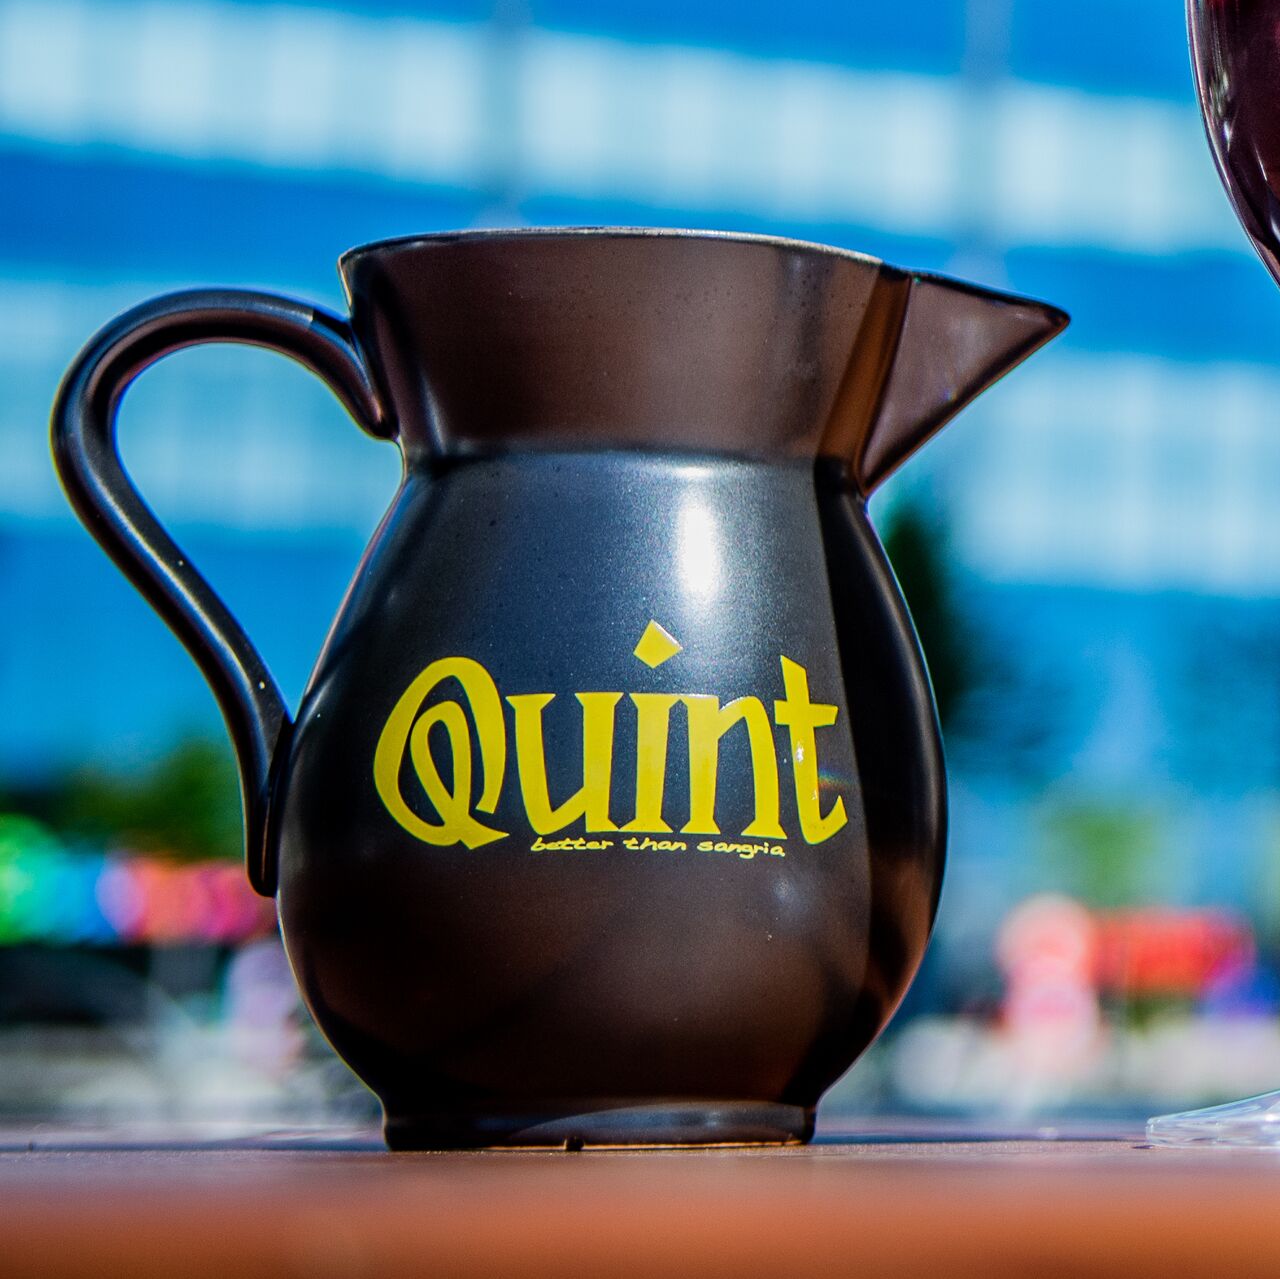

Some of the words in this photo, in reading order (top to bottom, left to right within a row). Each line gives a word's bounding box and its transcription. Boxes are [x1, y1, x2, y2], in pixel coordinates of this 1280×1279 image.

[373, 619, 848, 850] Quint
[530, 837, 614, 852] better
[622, 837, 687, 852] than
[696, 839, 786, 859] sangria
